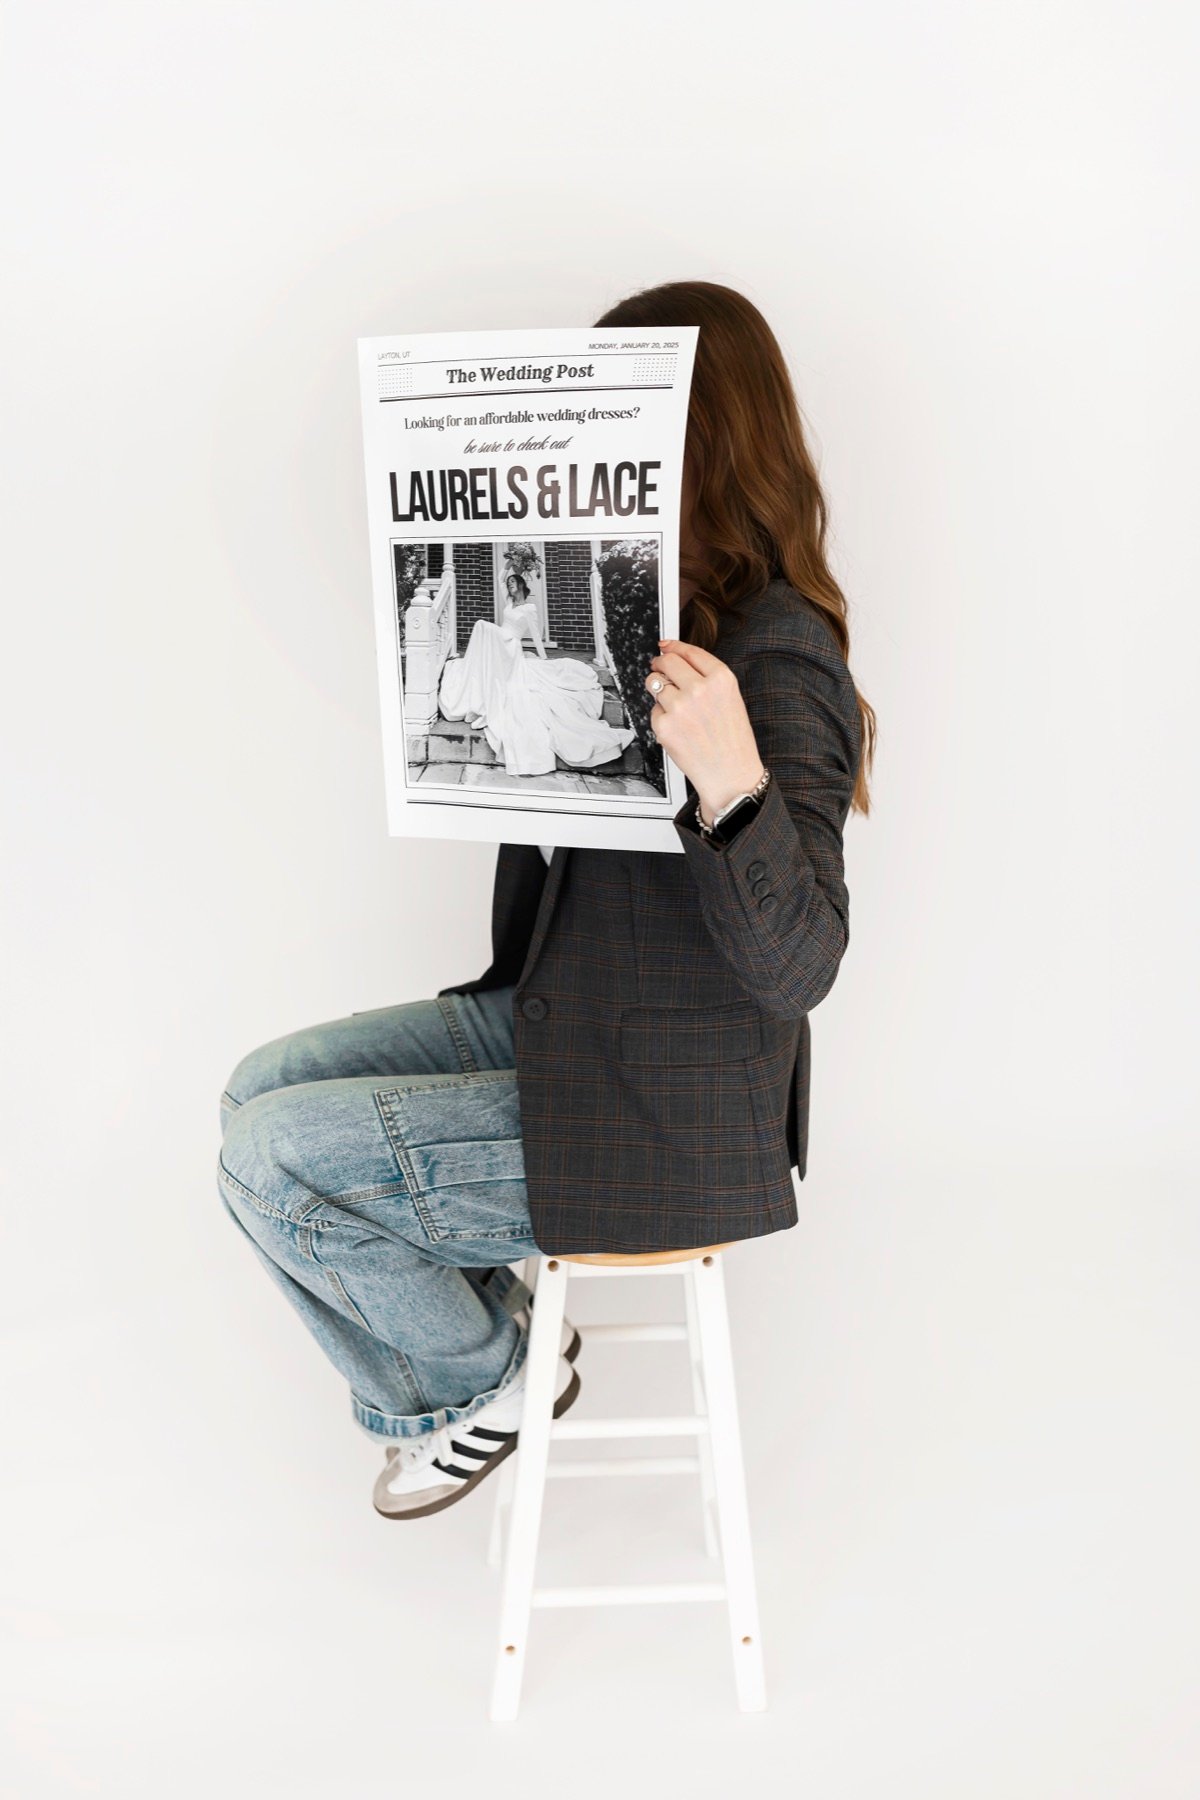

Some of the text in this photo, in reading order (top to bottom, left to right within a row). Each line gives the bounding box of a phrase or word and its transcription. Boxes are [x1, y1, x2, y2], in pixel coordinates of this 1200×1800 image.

[446, 364, 595, 384] The Wedding Post
[404, 406, 641, 431] Looking for an affordable wedding dresses?
[463, 435, 574, 454] be sure to check out
[389, 460, 662, 522] LAURELS & LACE
